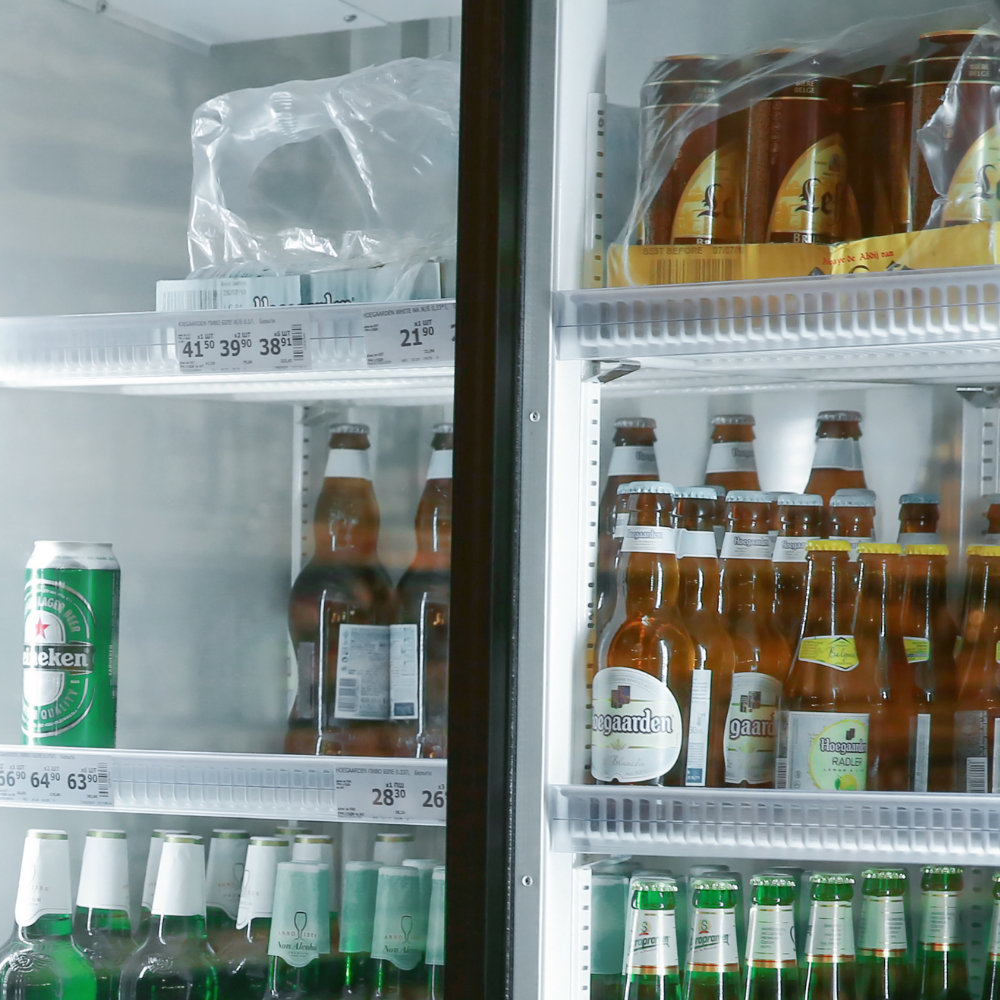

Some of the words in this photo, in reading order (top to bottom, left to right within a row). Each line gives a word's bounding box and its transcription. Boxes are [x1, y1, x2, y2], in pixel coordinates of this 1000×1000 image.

[643, 247, 664, 255] BEST
[666, 246, 703, 255] BEFORE
[41, 689, 79, 720] QUALITY
